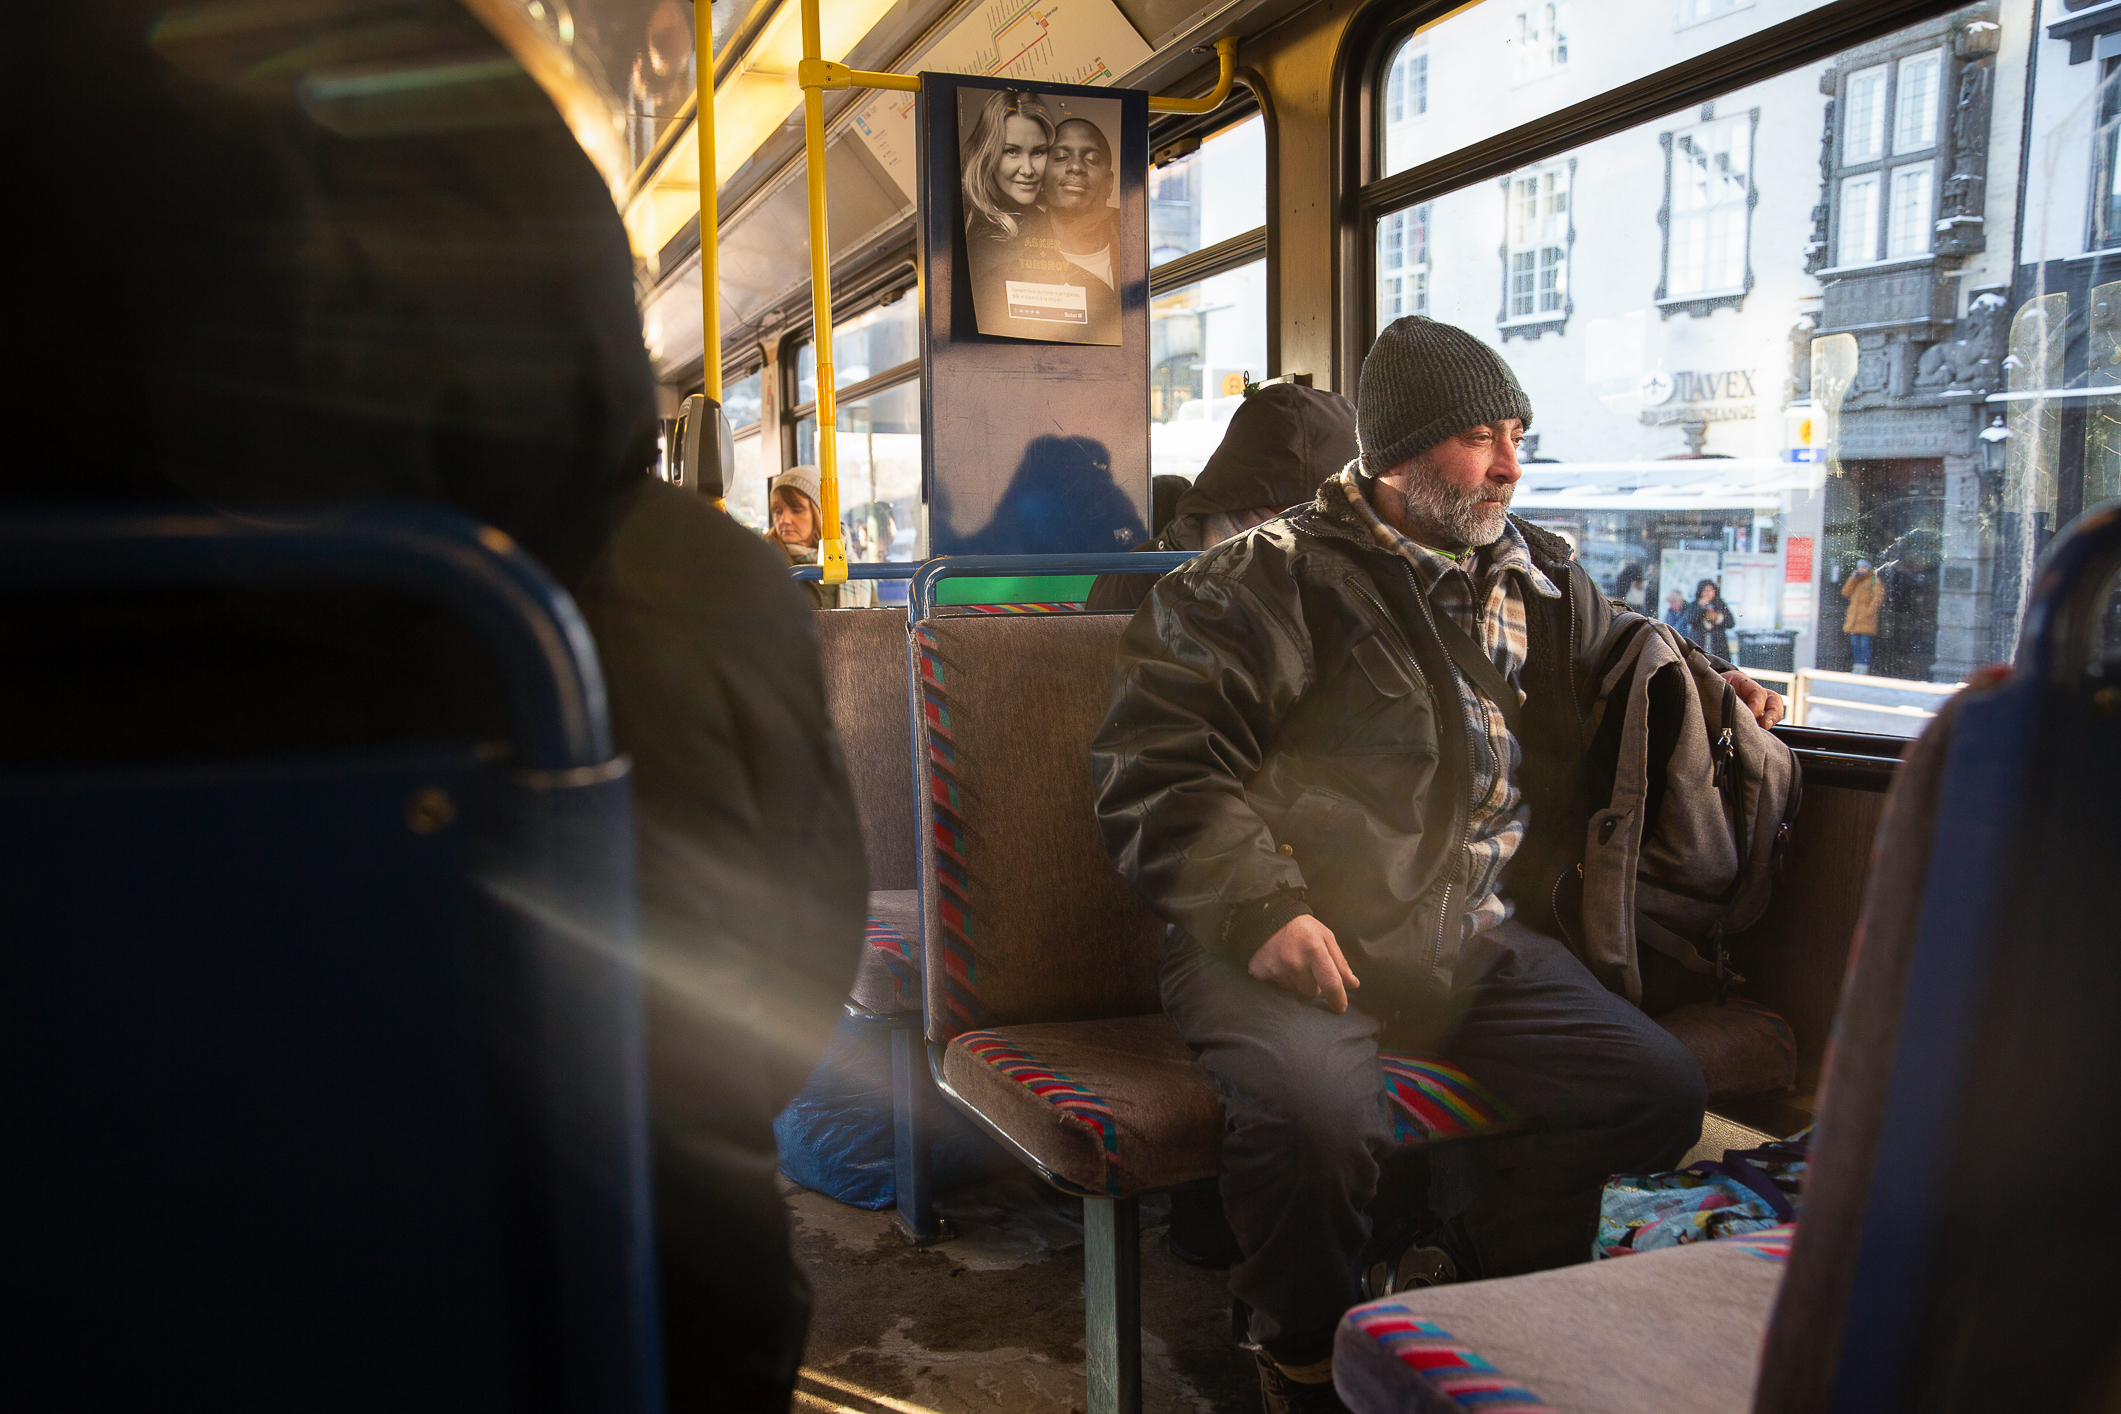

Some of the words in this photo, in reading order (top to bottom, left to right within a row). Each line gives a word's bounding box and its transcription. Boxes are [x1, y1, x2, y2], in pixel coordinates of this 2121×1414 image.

[1024, 237, 1061, 249] ASKER
[1019, 258, 1069, 271] TORSHOV
[1676, 369, 1757, 403] TAVEX
